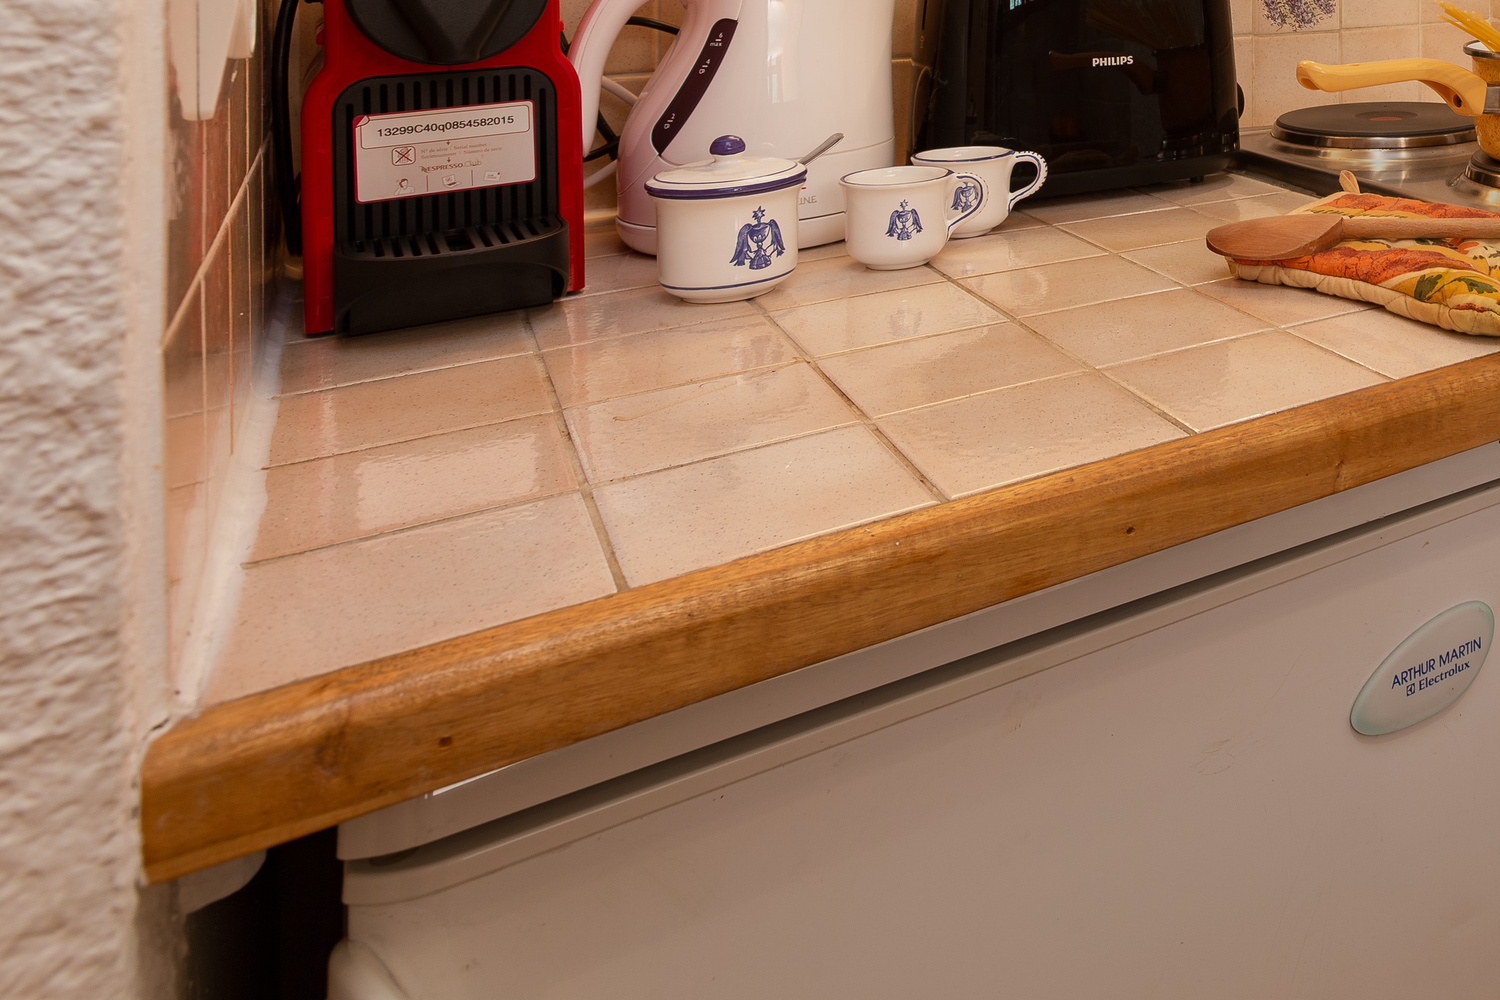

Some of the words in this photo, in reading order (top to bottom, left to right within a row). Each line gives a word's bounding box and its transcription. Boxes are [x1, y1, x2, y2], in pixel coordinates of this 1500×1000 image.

[1092, 55, 1134, 67] PHILIPS
[377, 115, 515, 137] 13299C40q0854582015
[419, 163, 463, 173] NESPRESSO
[1391, 658, 1436, 689] ARTHUR
[1439, 636, 1482, 668] MARTIN
[1418, 660, 1471, 692] Electrolux
